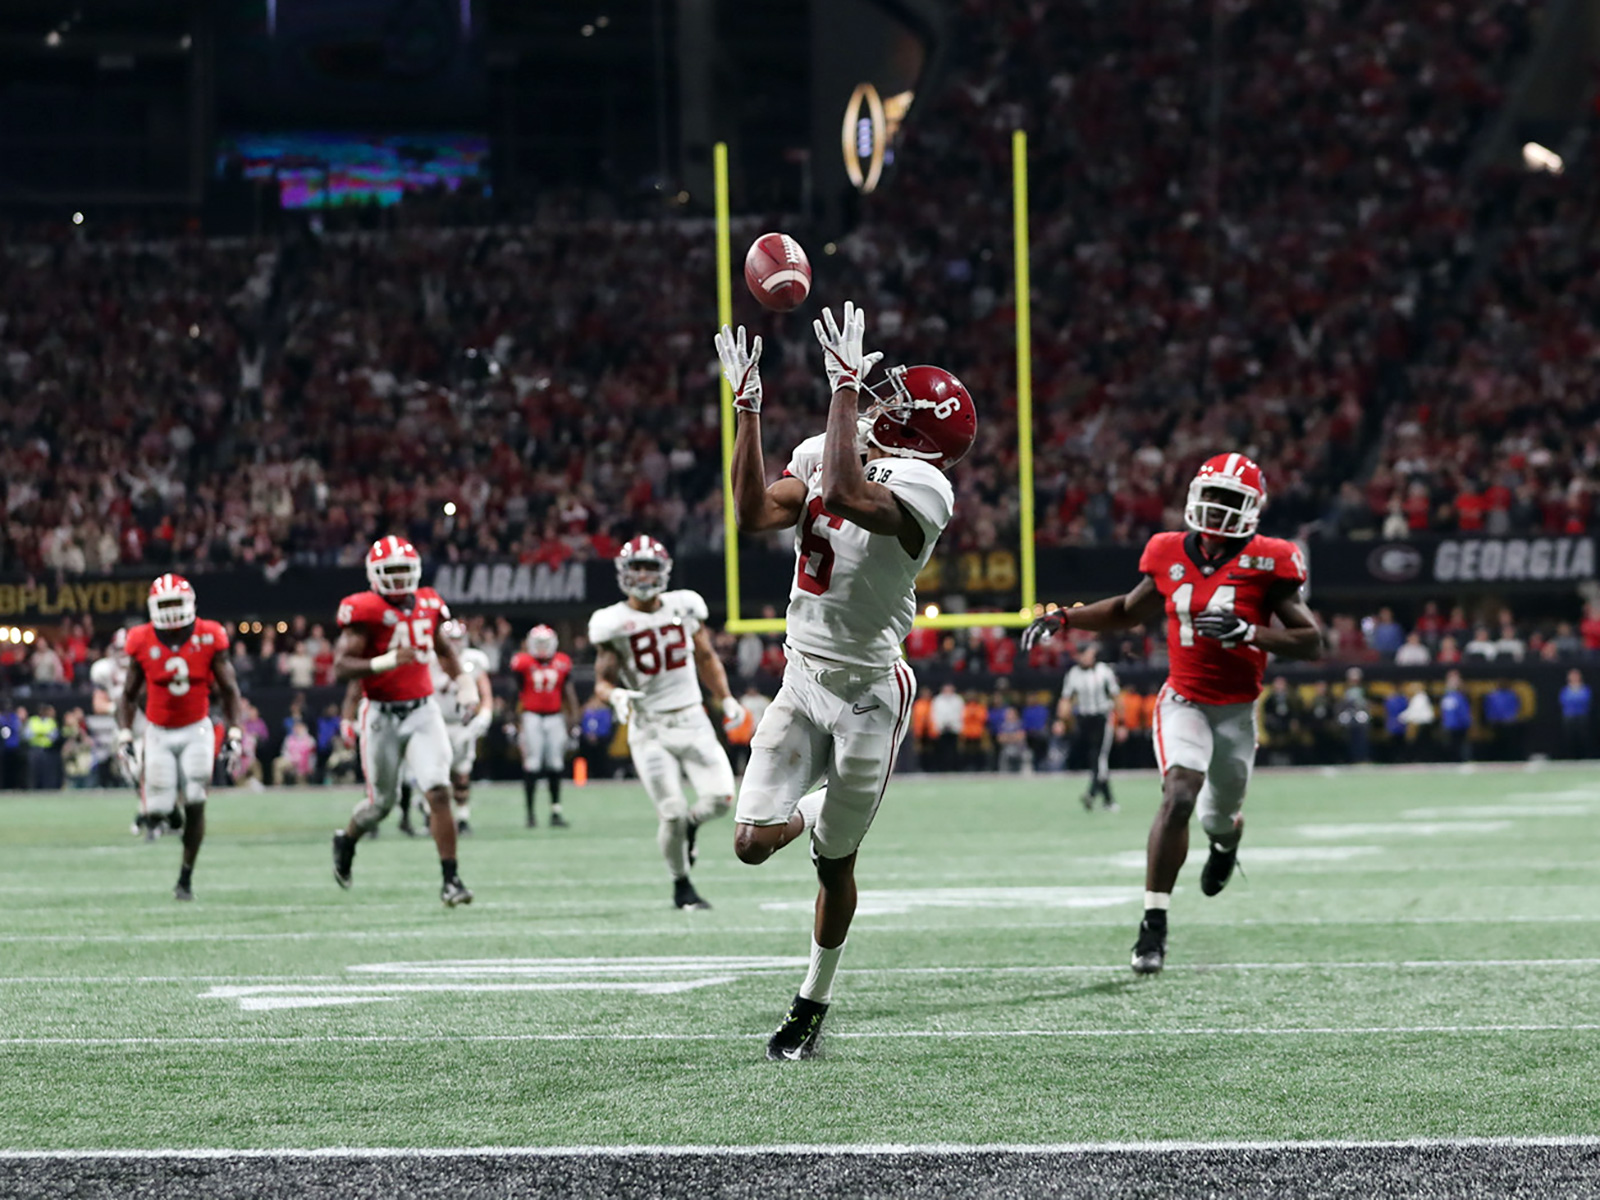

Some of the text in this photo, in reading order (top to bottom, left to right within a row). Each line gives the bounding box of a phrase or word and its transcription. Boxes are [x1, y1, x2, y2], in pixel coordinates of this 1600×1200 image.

[934, 396, 961, 420] 6
[797, 496, 845, 596] 6
[1433, 537, 1594, 582] GEORGIA
[433, 562, 585, 603] ALABAMA
[1171, 582, 1236, 648] 14
[387, 619, 436, 664] 45
[629, 624, 686, 675] 82
[164, 656, 190, 696] 3
